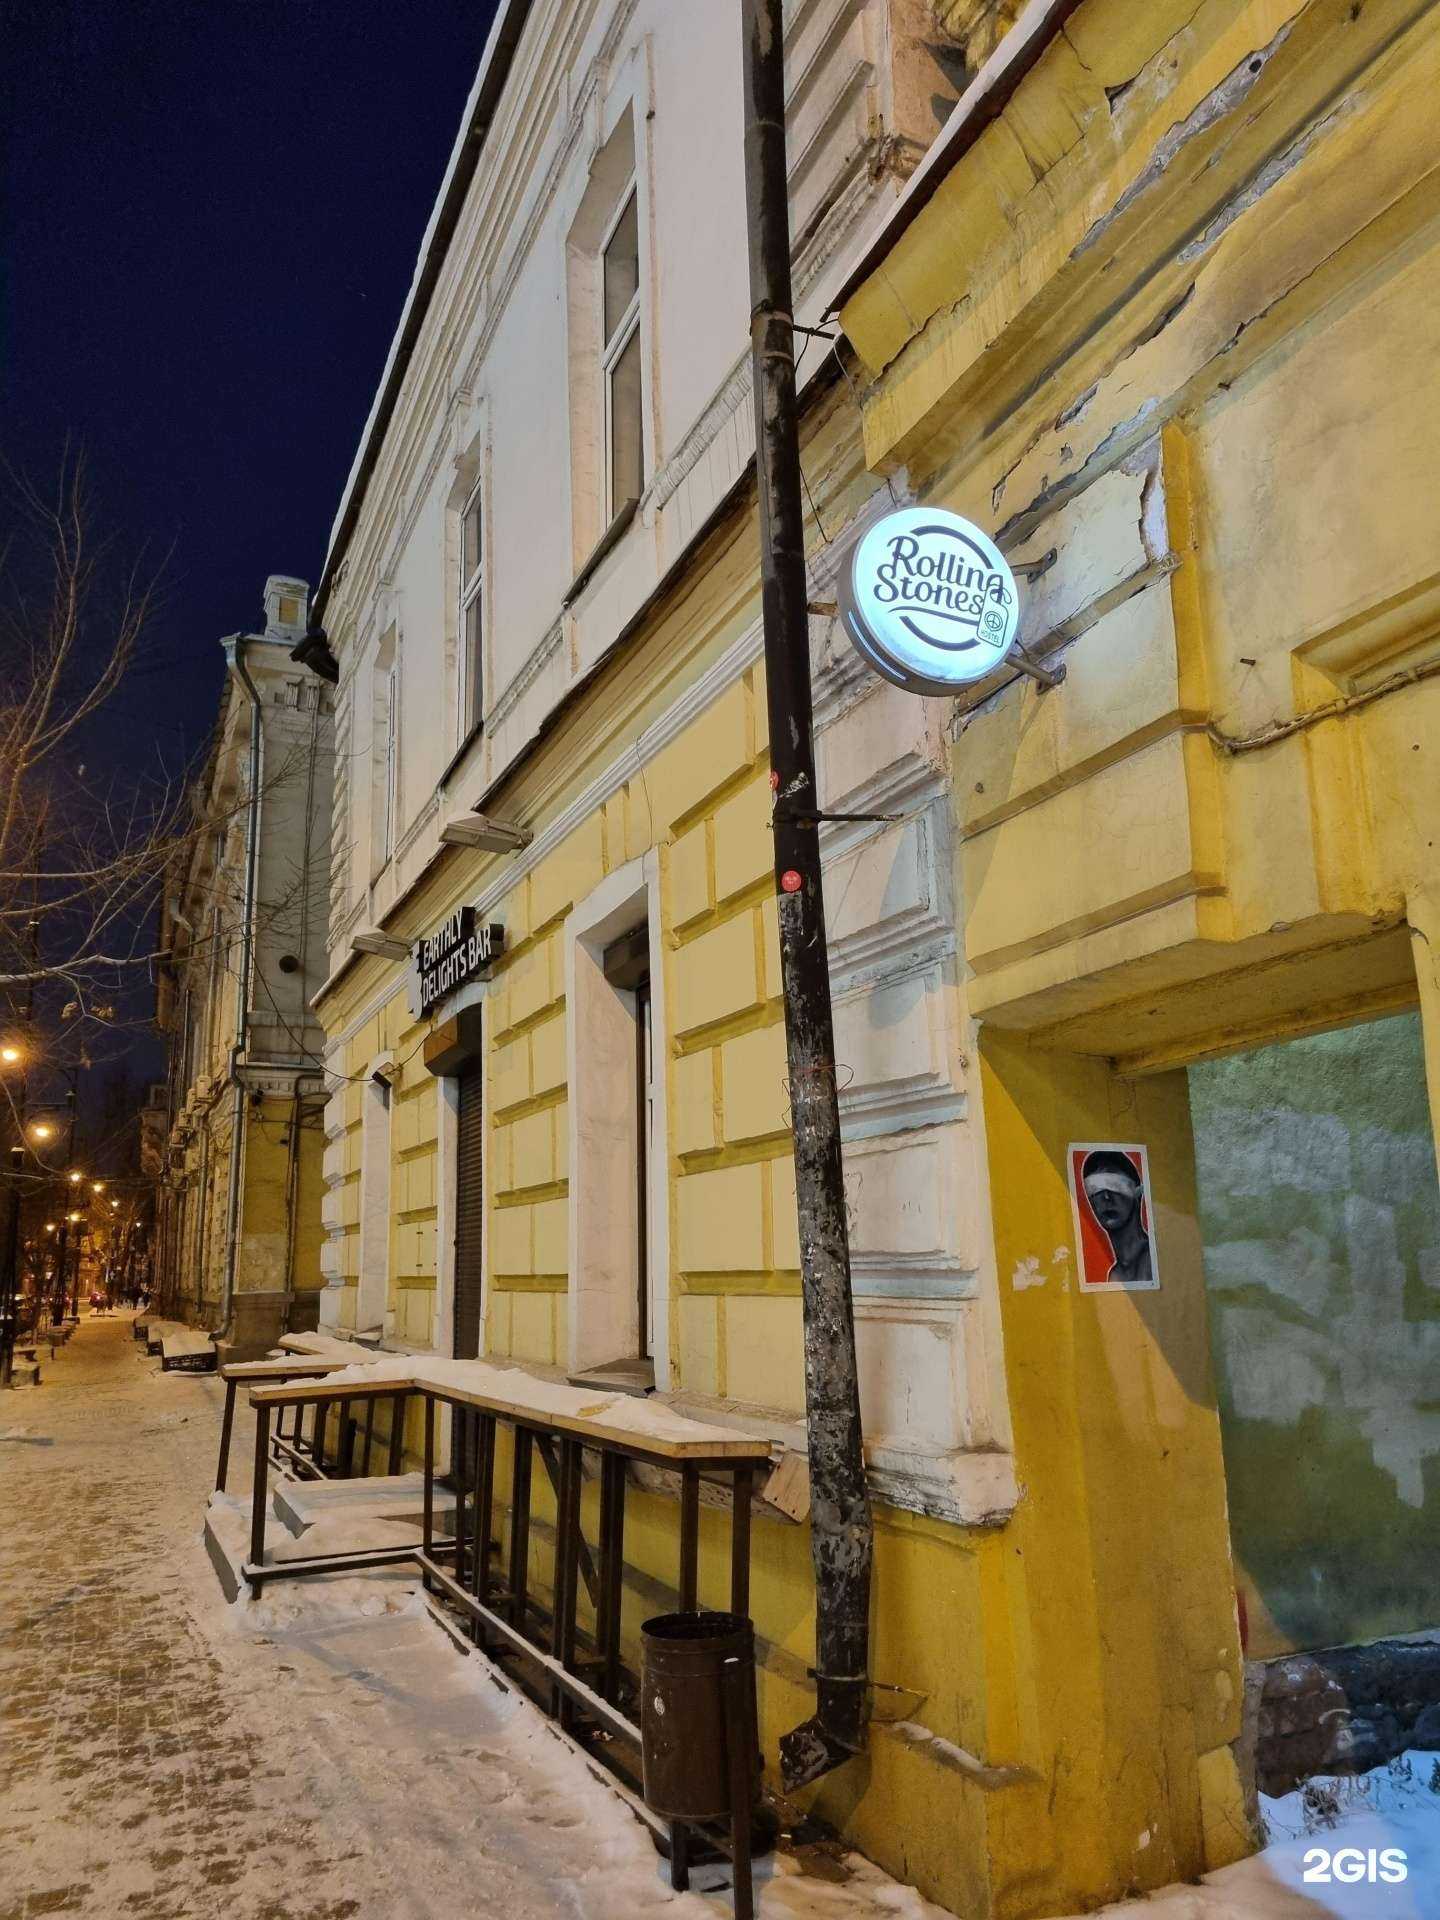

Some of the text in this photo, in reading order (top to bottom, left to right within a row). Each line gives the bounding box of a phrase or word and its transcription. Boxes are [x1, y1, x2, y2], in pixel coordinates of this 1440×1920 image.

[873, 563, 985, 616] Stones
[886, 535, 1004, 604] Rolling
[980, 629, 1001, 643] HOSTEL
[422, 926, 492, 1008] DELIGHTS BAR
[423, 907, 463, 971] EARTHLY
